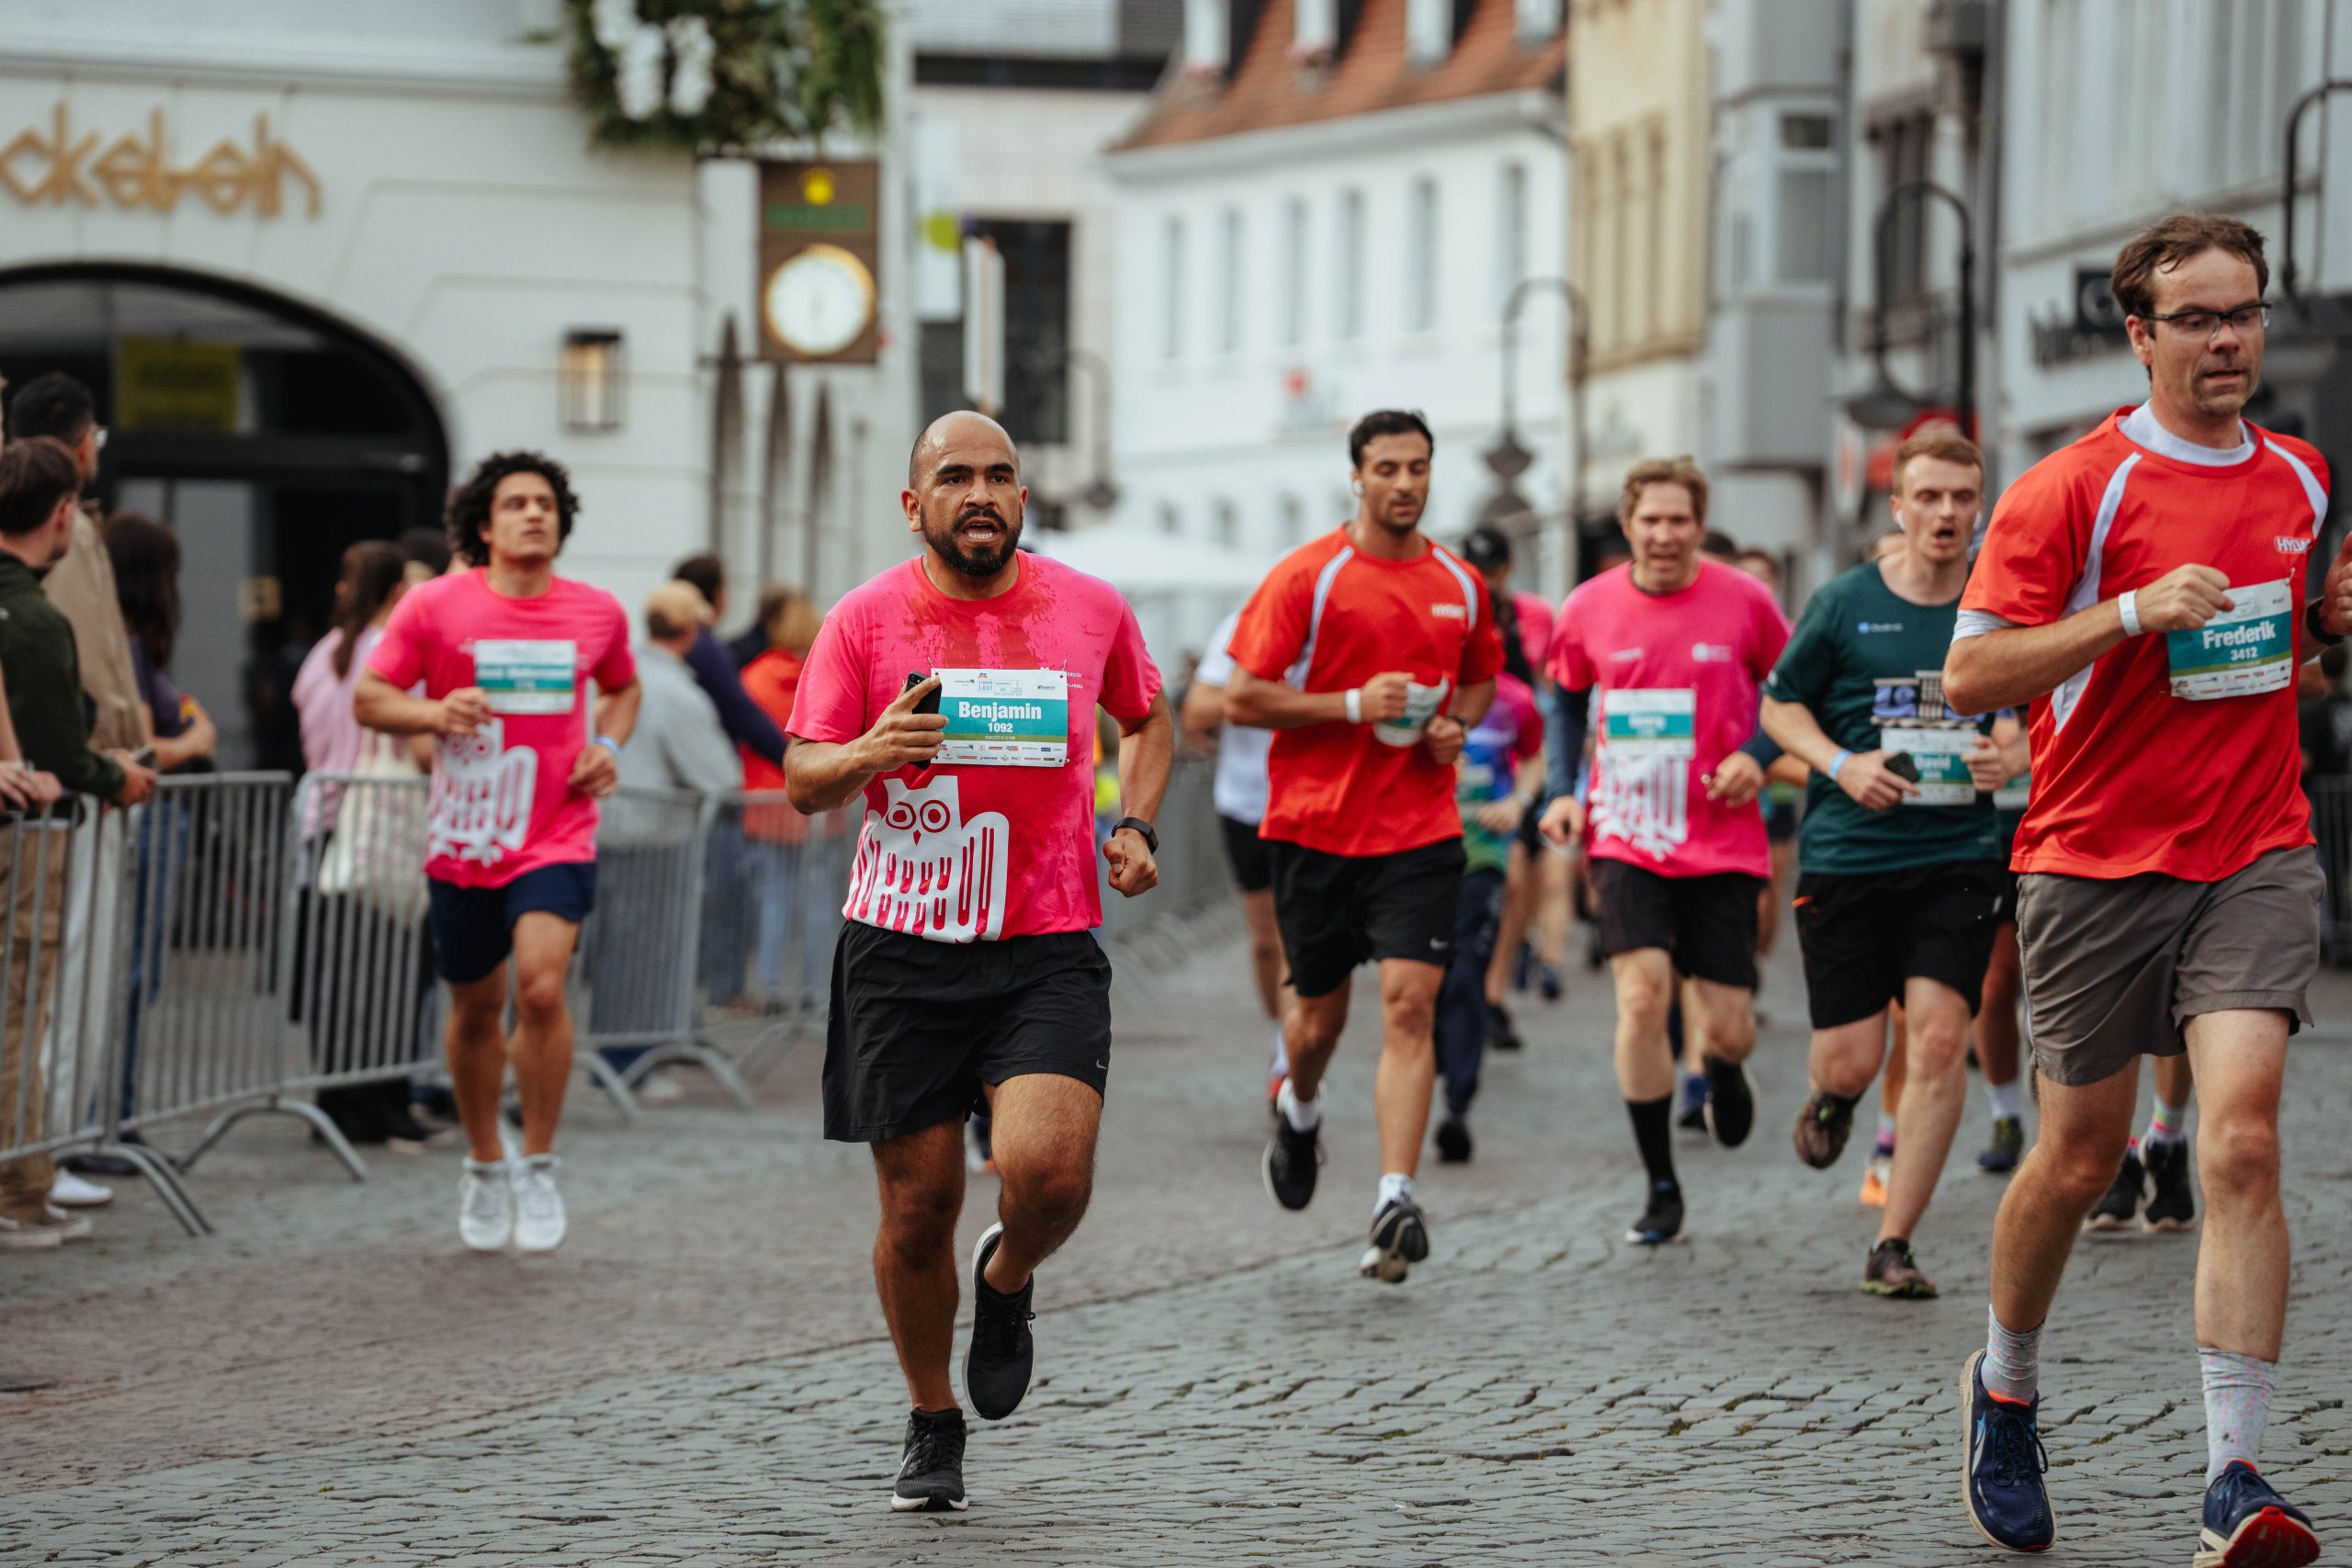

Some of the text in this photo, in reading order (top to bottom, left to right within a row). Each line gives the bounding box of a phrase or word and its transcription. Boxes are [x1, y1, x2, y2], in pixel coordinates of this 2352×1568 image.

[2201, 620, 2277, 649] Frederik
[2231, 646, 2258, 661] 3412
[958, 701, 1042, 722] Benjamin
[988, 722, 1013, 733] 1092
